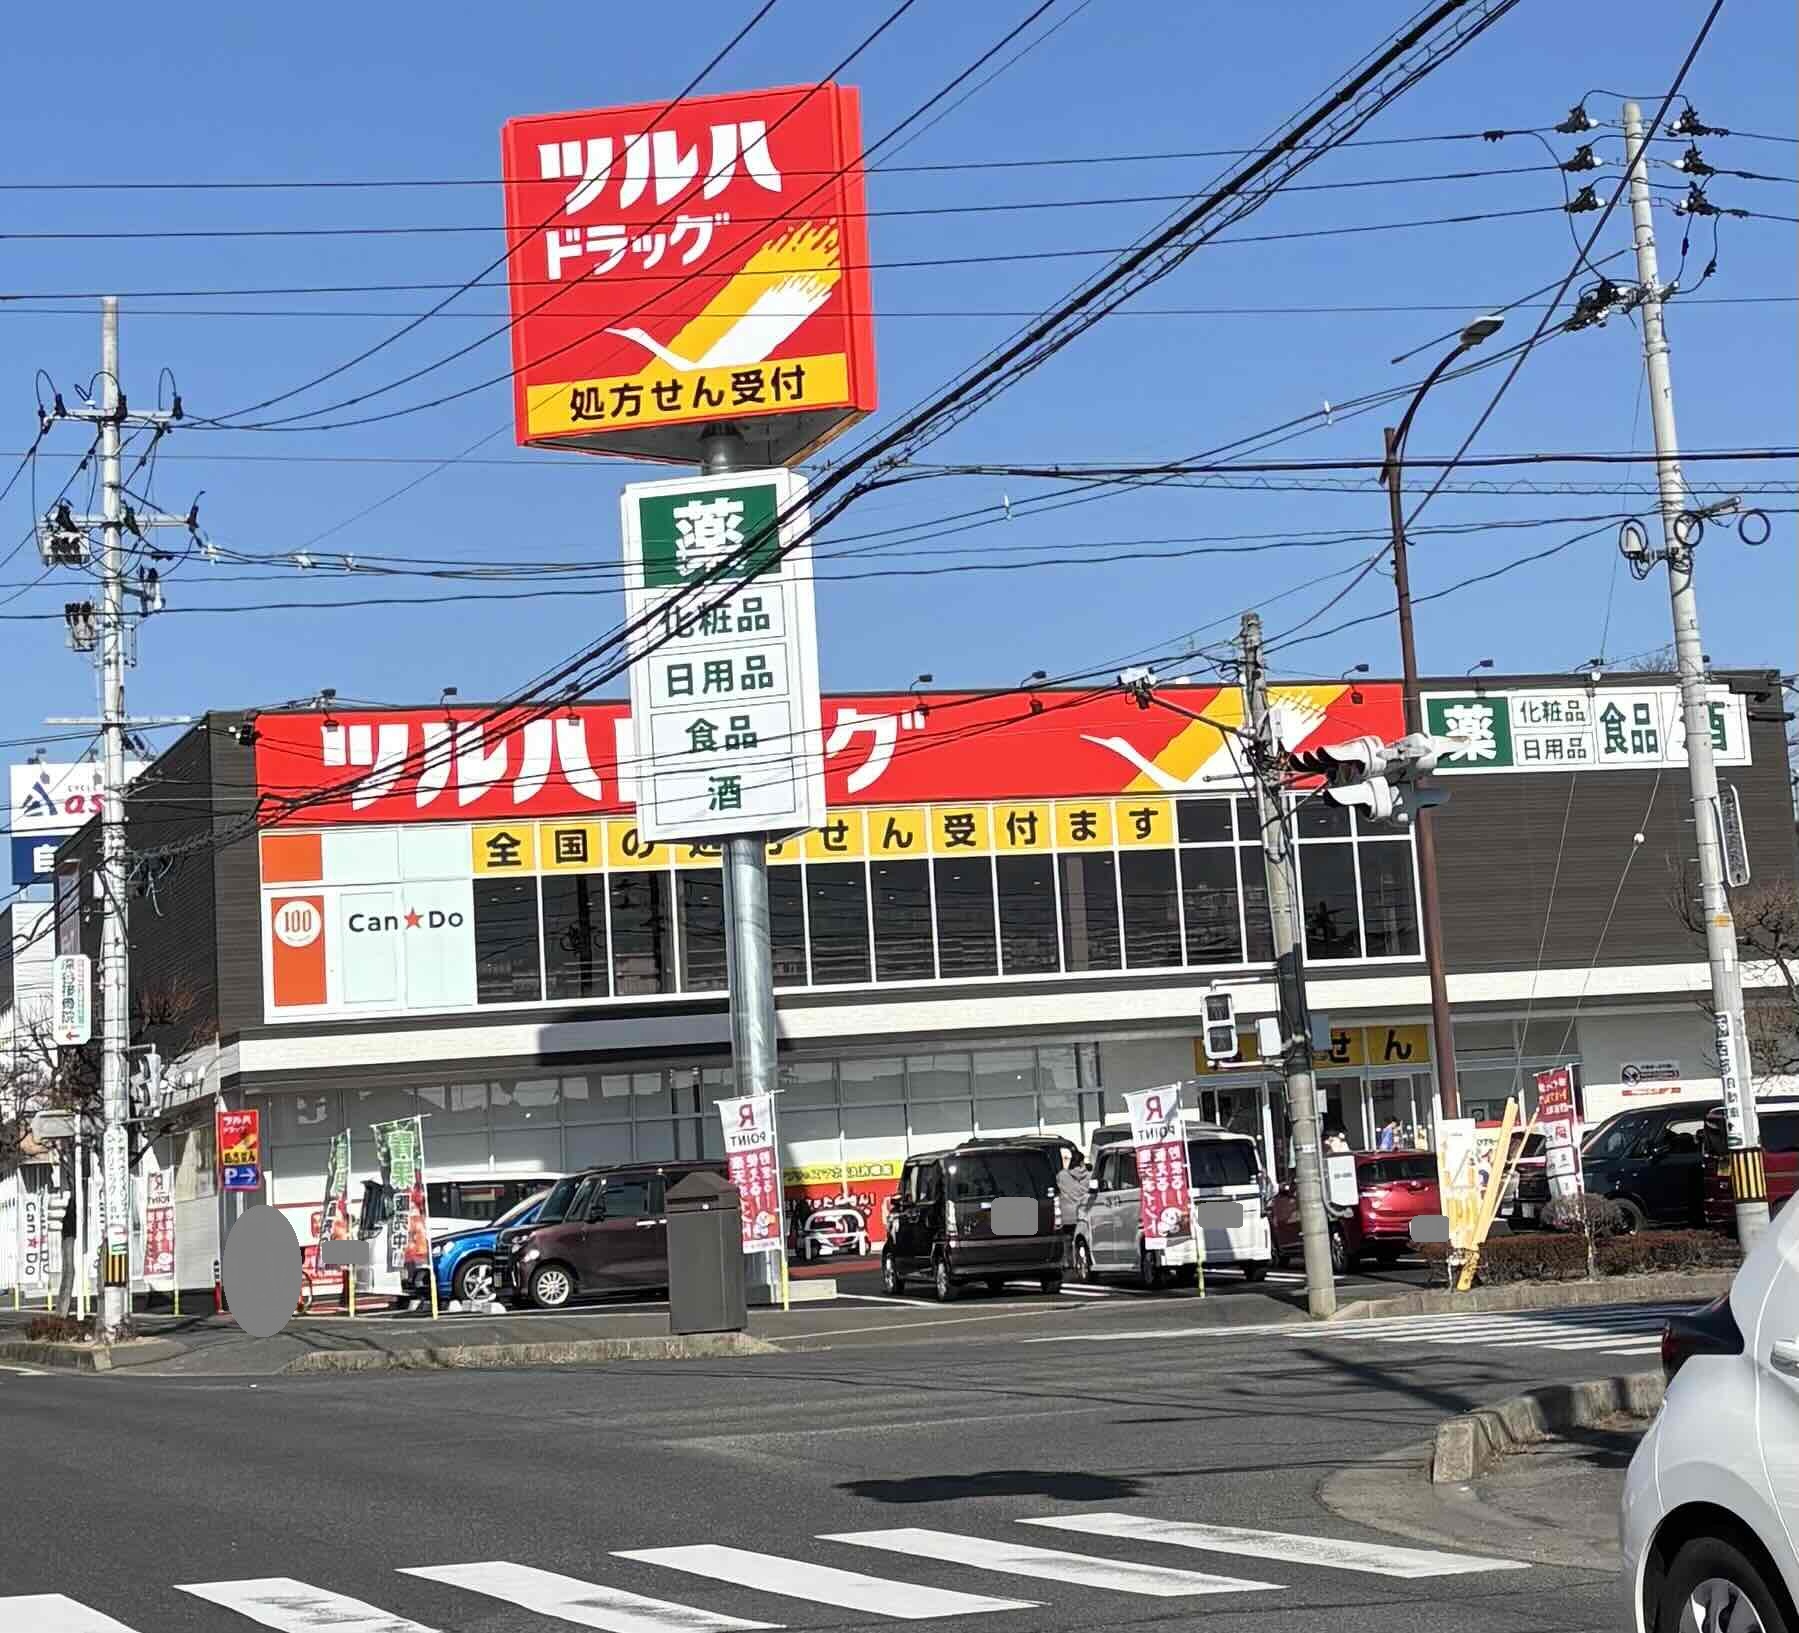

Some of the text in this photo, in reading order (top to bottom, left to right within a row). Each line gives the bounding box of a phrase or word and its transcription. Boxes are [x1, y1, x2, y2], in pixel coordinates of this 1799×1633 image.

[538, 120, 782, 215] ツルハ
[545, 211, 730, 280] ドラッグ
[570, 364, 806, 422] 処方せん受付
[673, 497, 746, 575] 薬
[662, 596, 771, 638] 化粧品
[666, 655, 774, 697] 日用品
[1444, 704, 1497, 761] 薬
[1520, 701, 1587, 724] 化粧品
[1600, 701, 1659, 756] 食品
[685, 715, 758, 753] 食品
[1523, 737, 1588, 761] 日用品
[708, 776, 743, 811] 酒
[486, 807, 1159, 868] 全国のせん受付ます
[284, 909, 312, 933] 100
[224, 1167, 238, 1185] P
